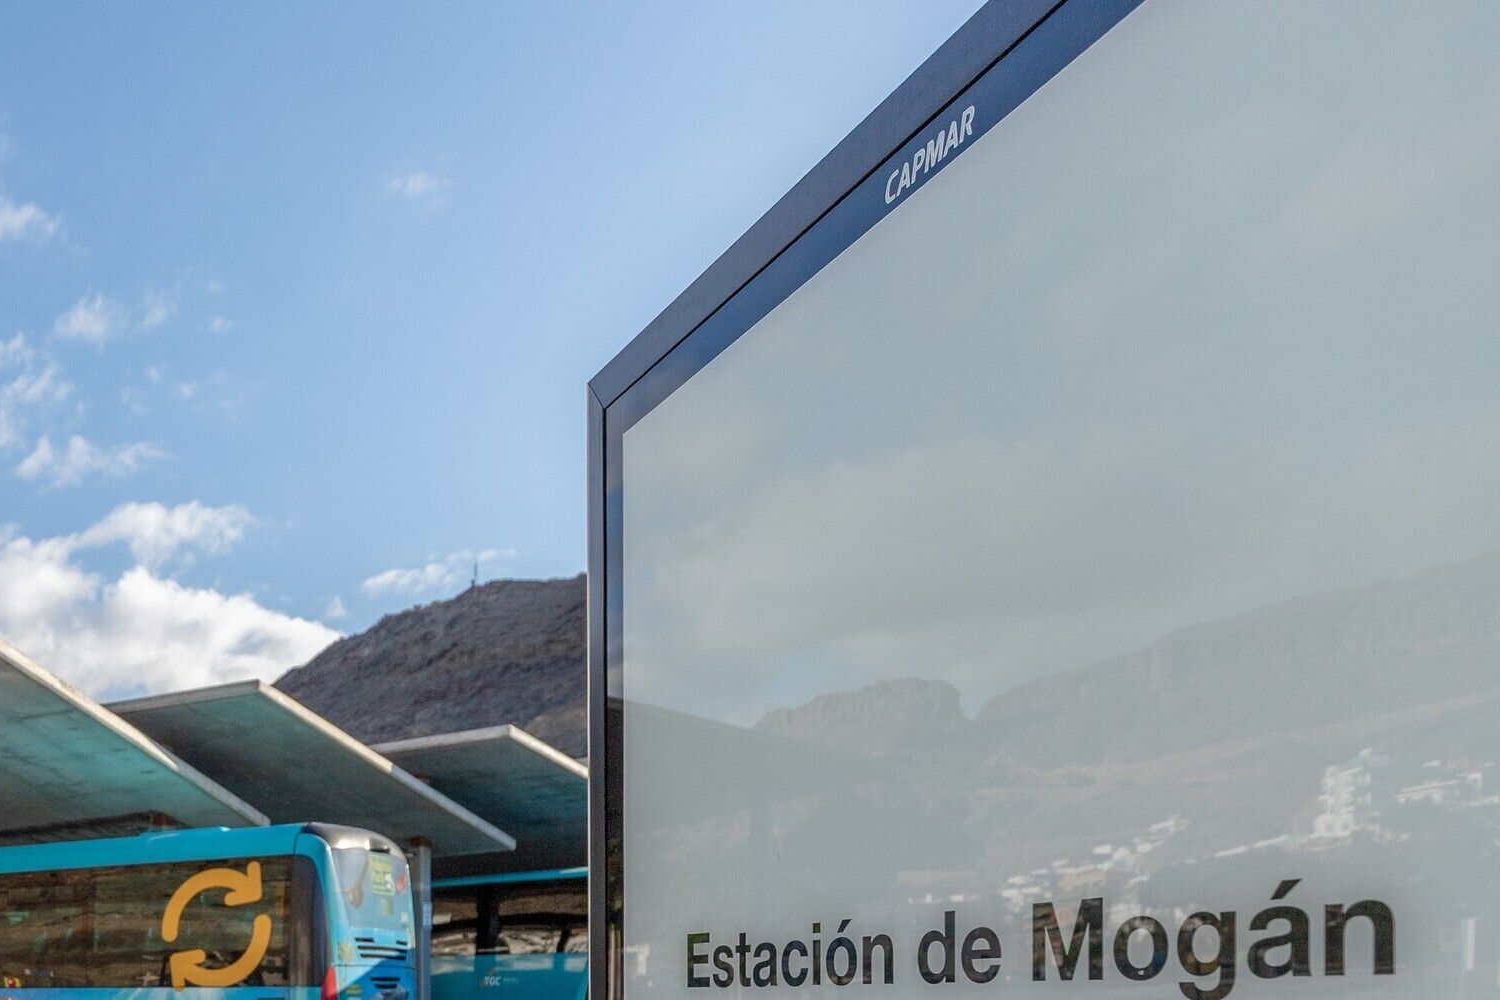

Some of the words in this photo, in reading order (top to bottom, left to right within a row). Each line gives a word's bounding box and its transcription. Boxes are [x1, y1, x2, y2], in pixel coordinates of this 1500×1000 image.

[885, 105, 975, 204] CAPMAR
[485, 976, 501, 986] TGC
[686, 919, 895, 988] Estación
[917, 910, 1002, 984] de
